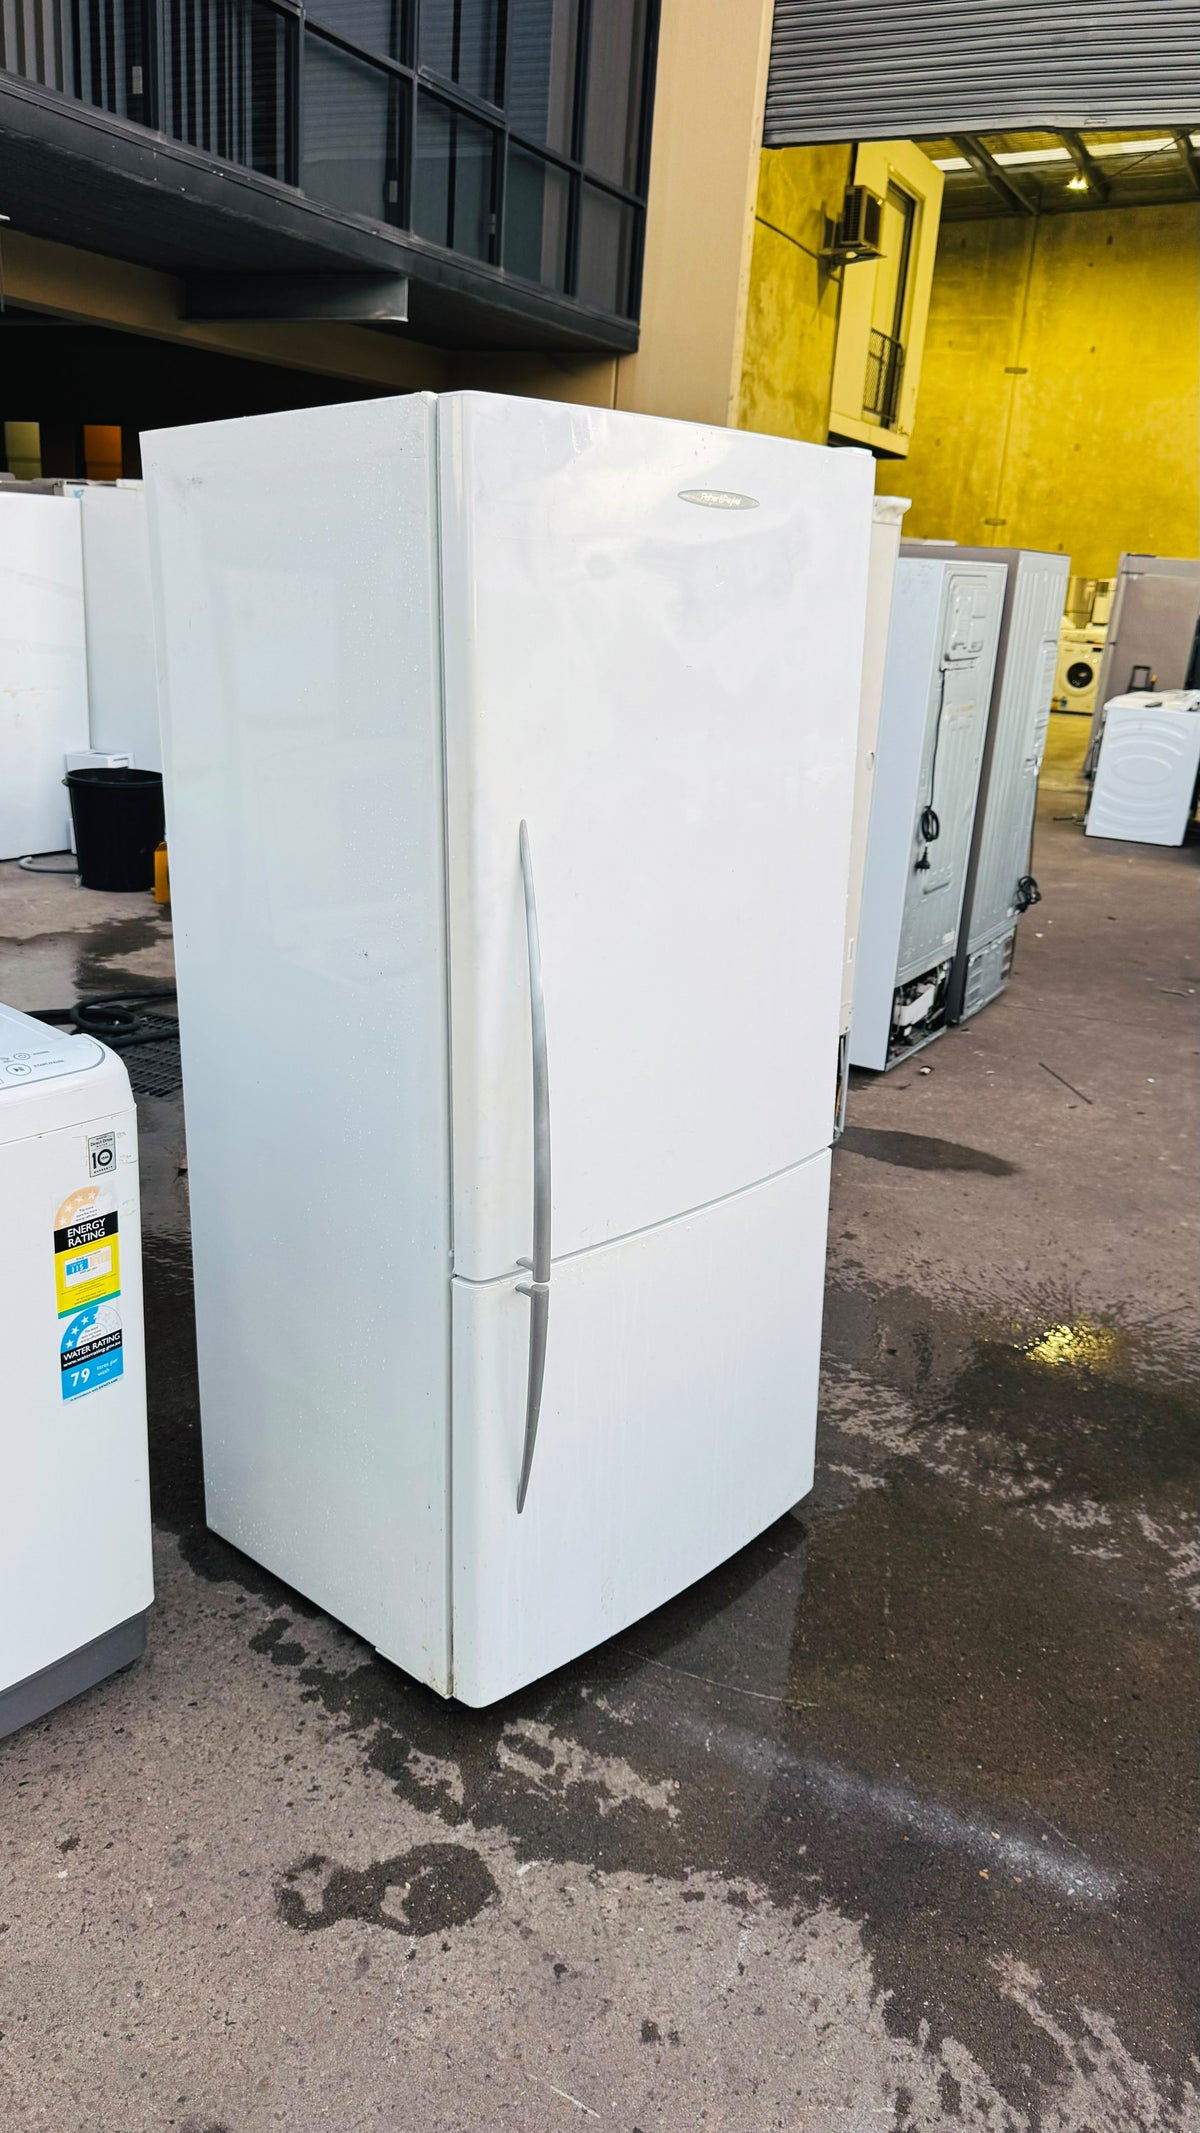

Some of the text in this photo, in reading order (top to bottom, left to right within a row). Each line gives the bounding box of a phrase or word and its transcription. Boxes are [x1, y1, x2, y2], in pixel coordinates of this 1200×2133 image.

[92, 1149, 113, 1169] 10
[67, 1218, 105, 1238] ENERGY
[68, 1228, 106, 1248] RATING
[63, 1345, 91, 1361] WATER
[92, 1332, 121, 1350] RATING
[70, 1367, 91, 1387] 79
